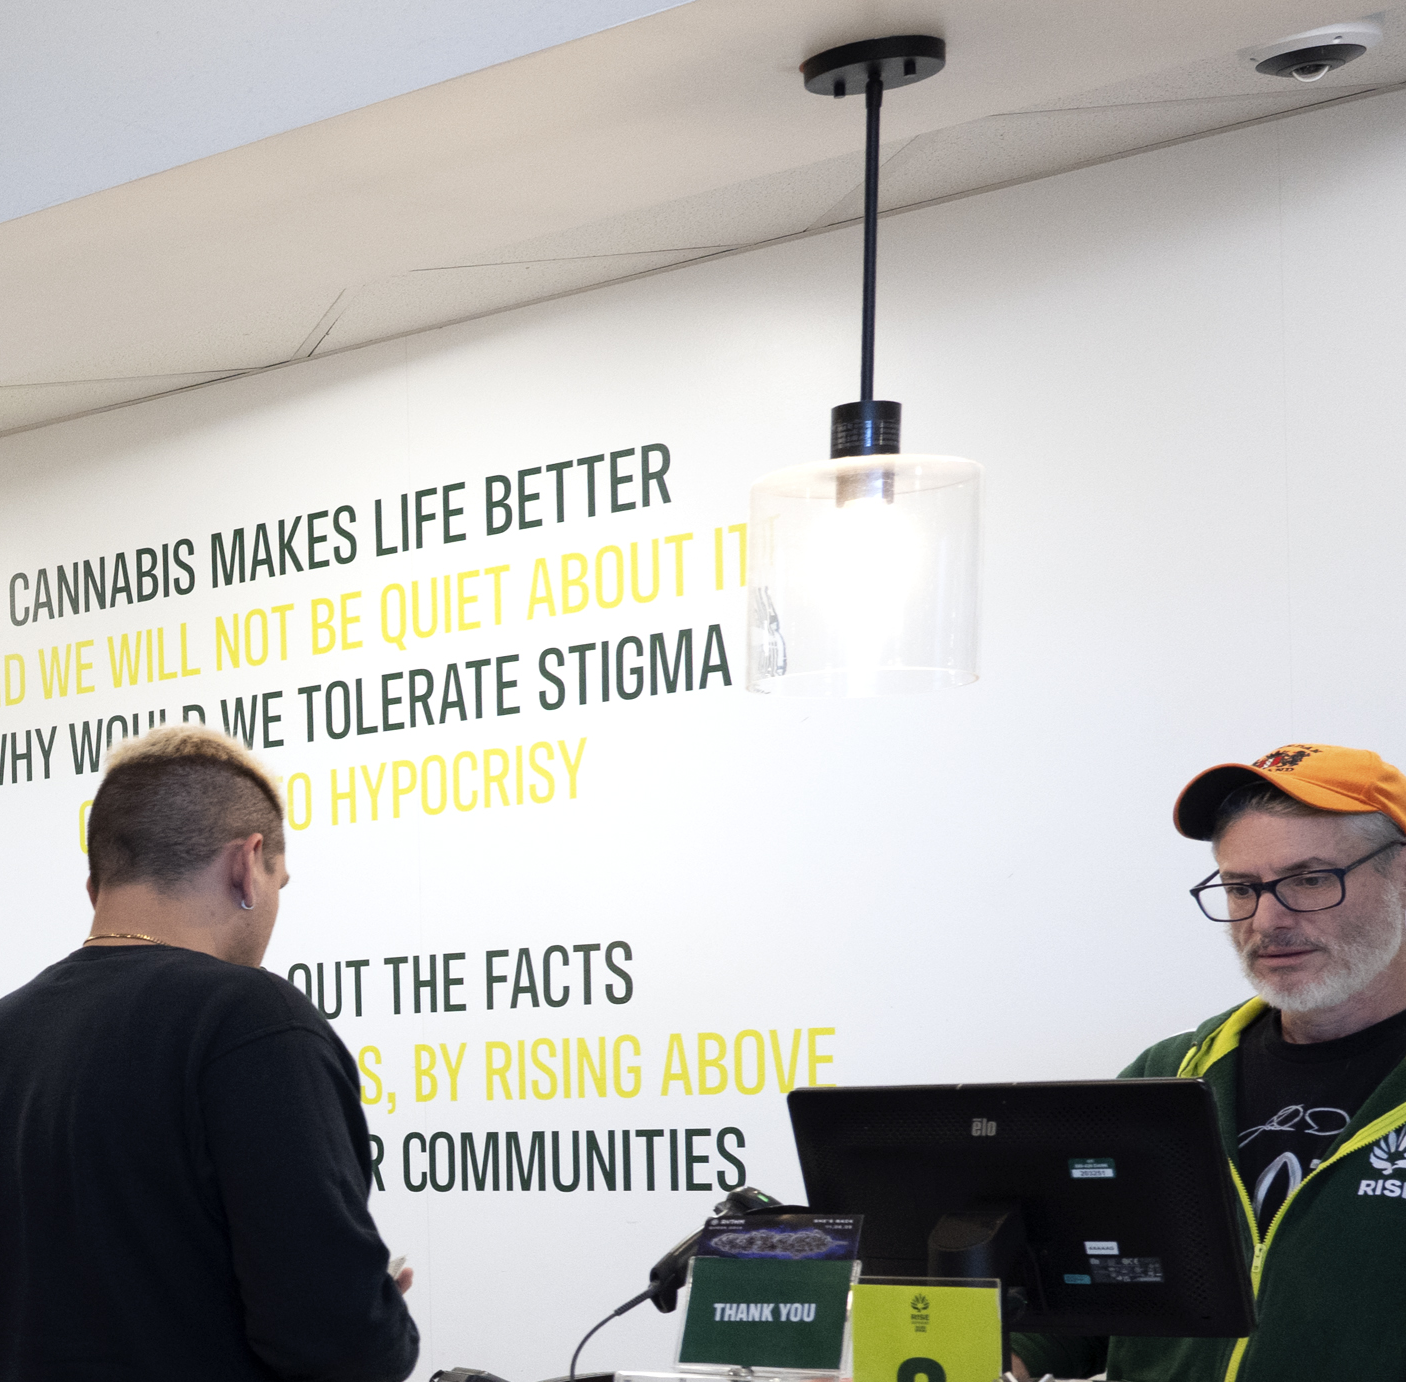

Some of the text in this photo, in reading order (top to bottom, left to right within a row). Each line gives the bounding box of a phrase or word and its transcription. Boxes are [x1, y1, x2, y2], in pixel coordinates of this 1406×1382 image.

[9, 443, 671, 626] CANNABIS MAKES LIFE BETTER
[38, 640, 95, 700] WE
[107, 622, 201, 688] WILL
[215, 603, 294, 671] NOT
[311, 590, 363, 655] BE
[380, 564, 510, 651] QUIET
[527, 532, 694, 621] ABOUT
[714, 522, 748, 590] IT
[220, 691, 284, 750] WE
[297, 653, 520, 742] TOLERATE
[538, 624, 732, 710] STIGMA
[275, 737, 587, 831] O HYPOCRISY
[287, 940, 634, 1019] OUT THE FACTS
[414, 1042, 467, 1103] BY
[485, 1034, 641, 1101] RISING
[661, 1027, 837, 1097] ABOVE
[403, 1126, 747, 1193] COMMUNITIES
[1357, 1179, 1406, 1199] RIS
[713, 1303, 817, 1322] THANK YOU
